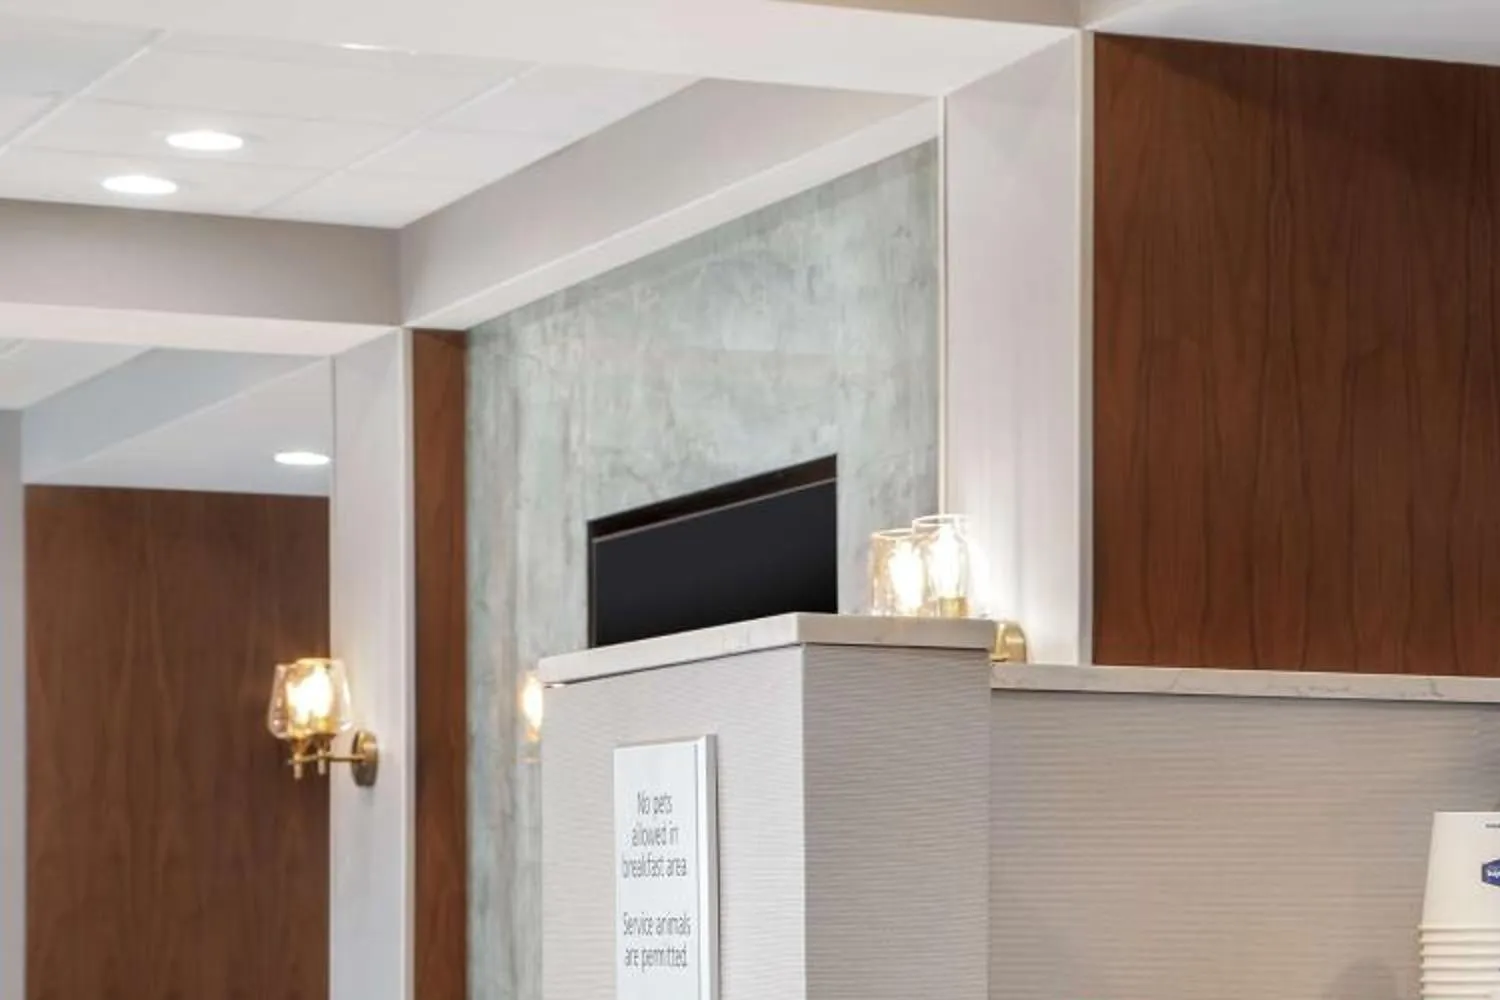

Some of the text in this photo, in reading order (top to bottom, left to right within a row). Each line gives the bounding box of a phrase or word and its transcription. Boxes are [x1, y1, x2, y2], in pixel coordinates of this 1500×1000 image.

[637, 791, 673, 819] No pets
[631, 820, 680, 847] allowed in
[621, 851, 687, 879] breakfast area
[623, 911, 691, 937] Service animals
[624, 948, 639, 967] are
